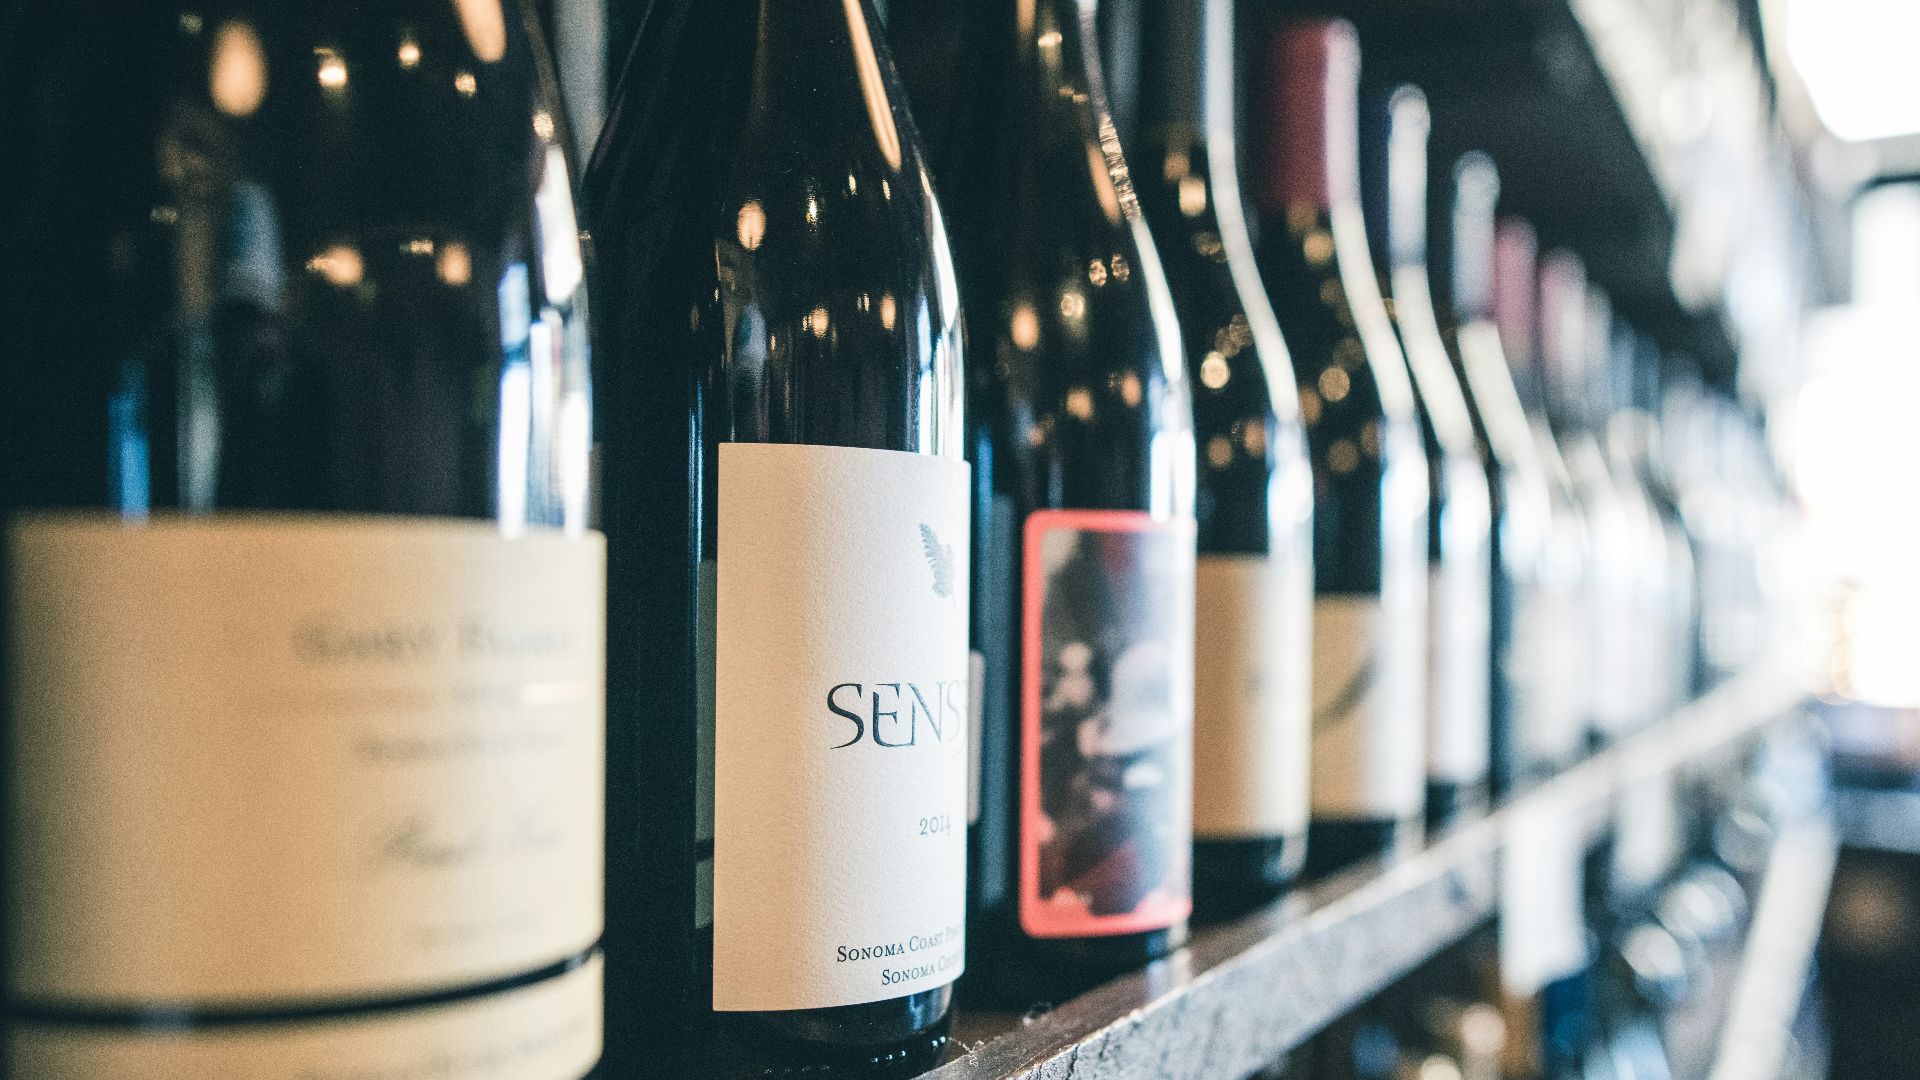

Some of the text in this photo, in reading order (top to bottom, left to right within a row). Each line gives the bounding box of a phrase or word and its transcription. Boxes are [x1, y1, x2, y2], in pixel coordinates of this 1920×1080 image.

[826, 681, 967, 752] SENS
[919, 813, 951, 836] 2014
[837, 942, 905, 962] SONOMA
[909, 932, 944, 952] COAST
[881, 964, 935, 986] SONOMA
